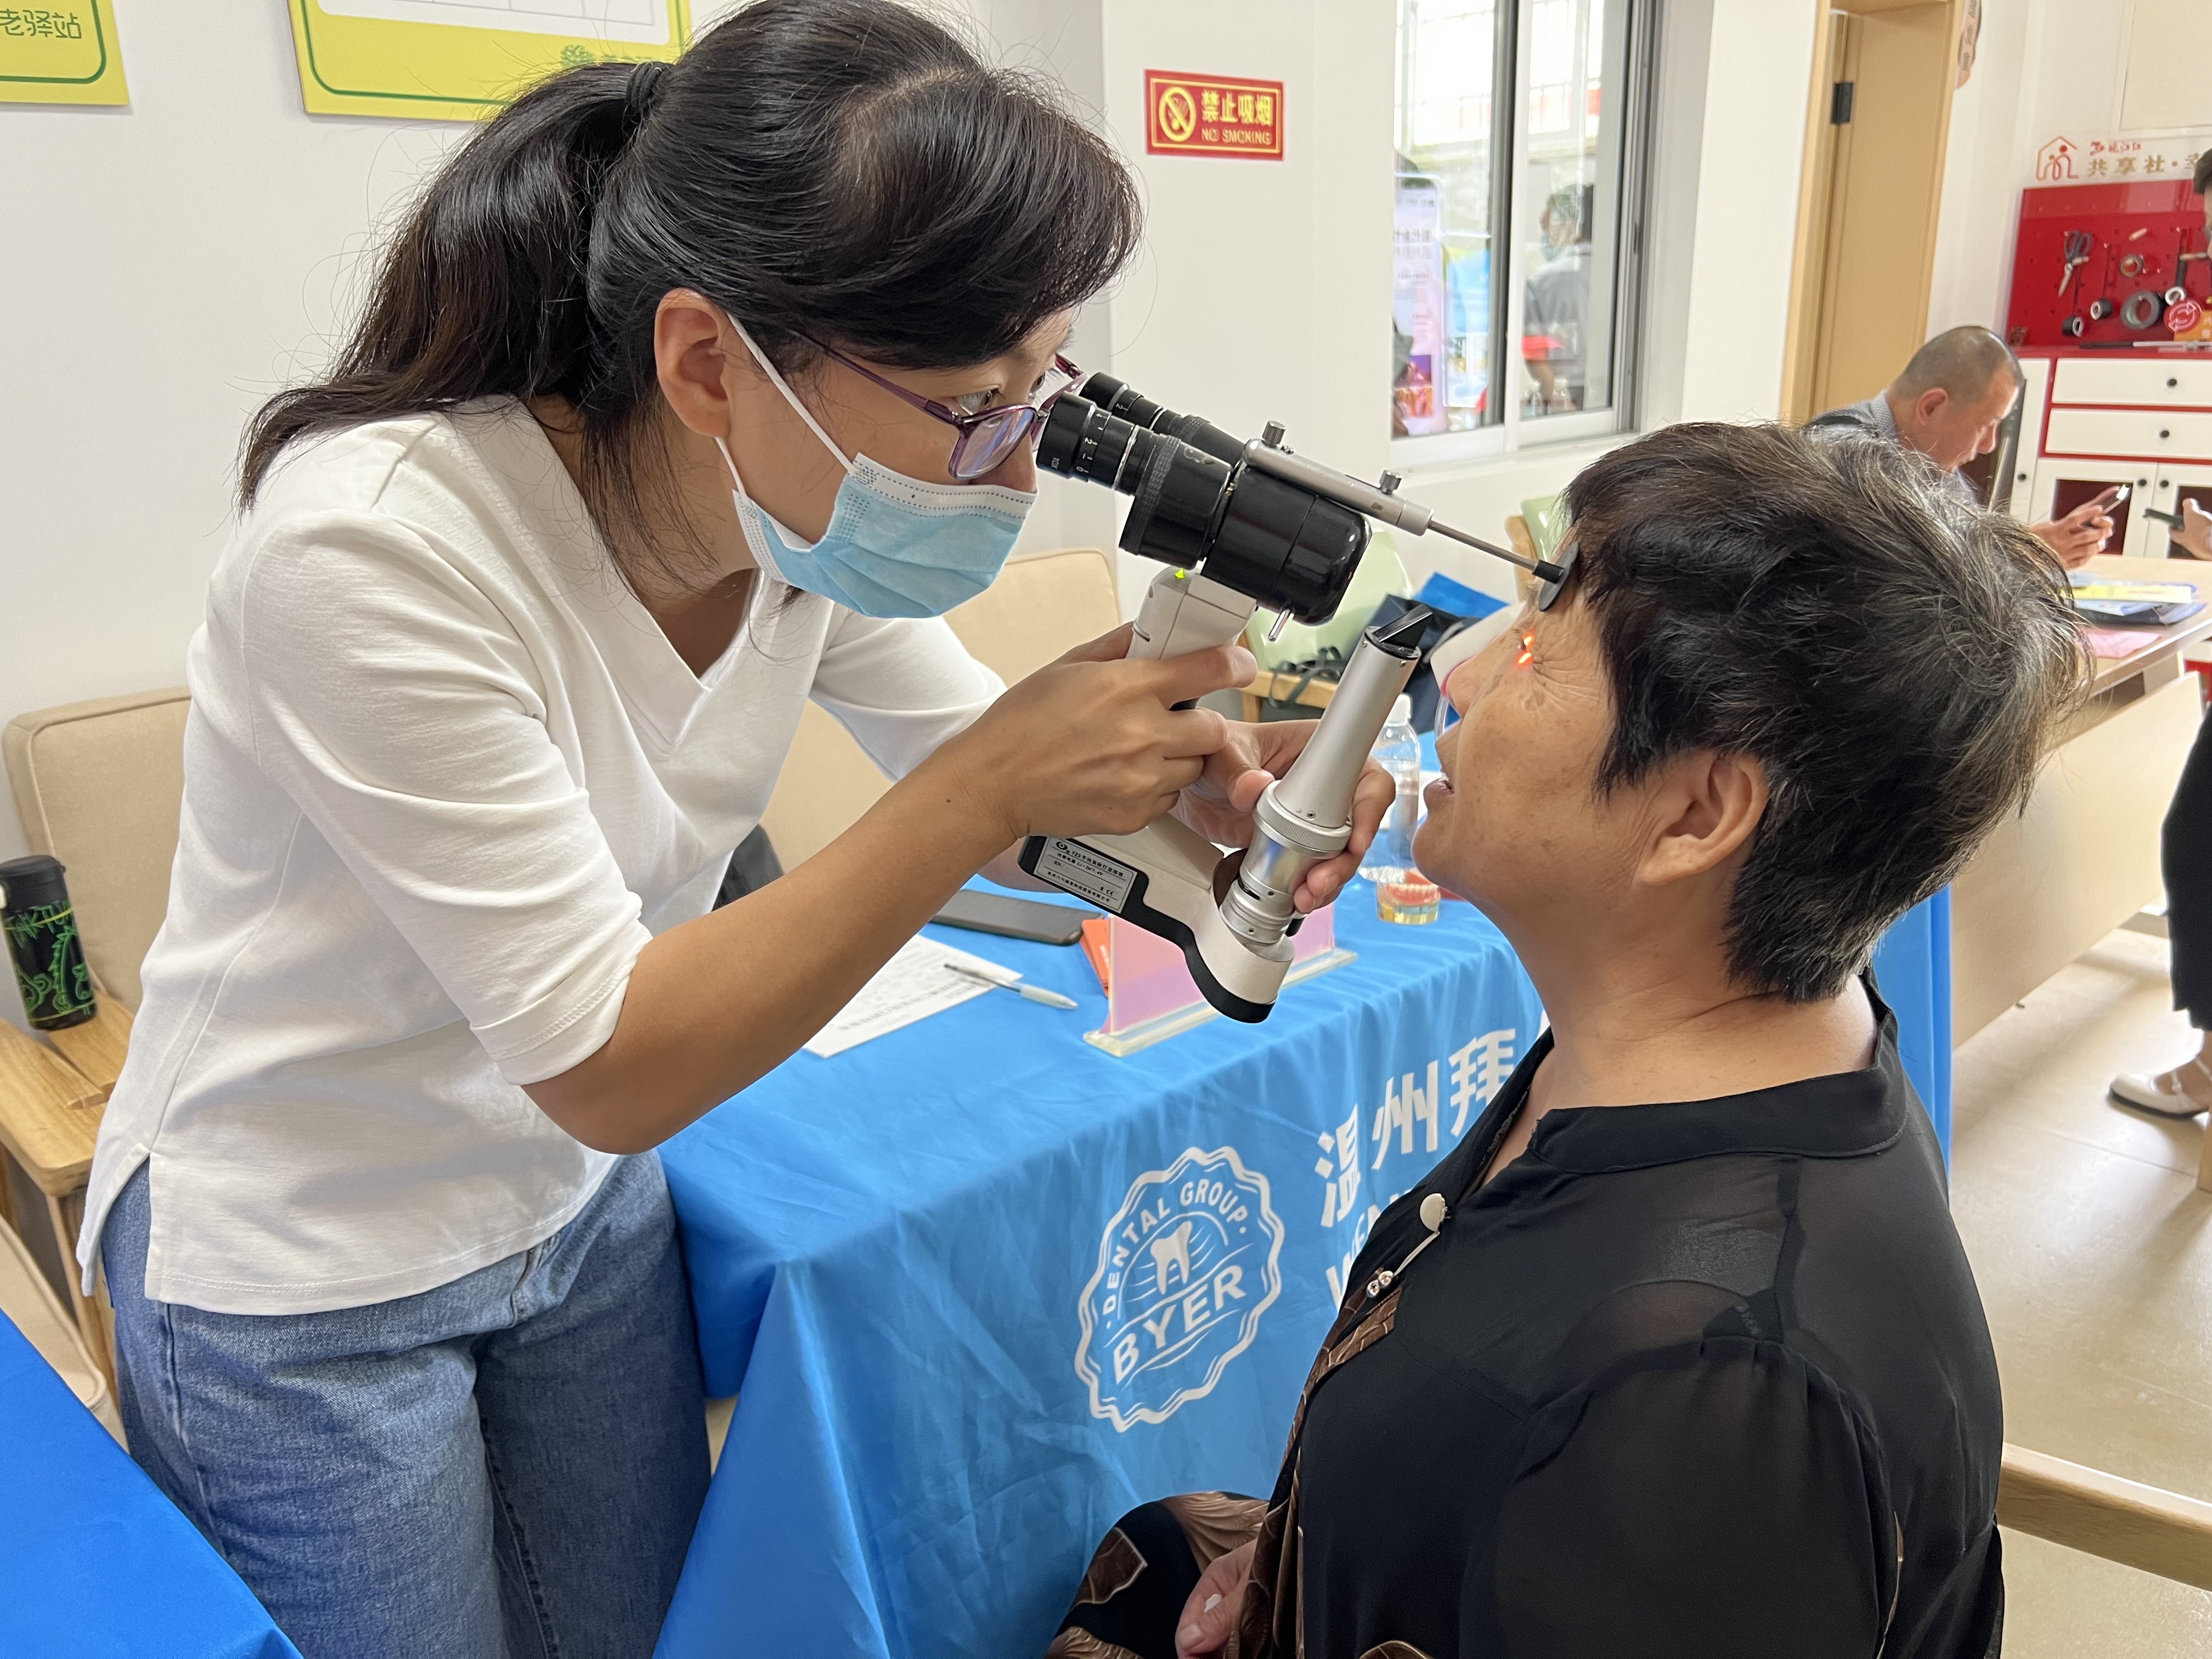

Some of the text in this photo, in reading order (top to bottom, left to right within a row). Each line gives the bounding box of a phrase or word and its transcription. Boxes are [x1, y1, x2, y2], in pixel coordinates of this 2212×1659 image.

[0, 9, 82, 39] 老驿站
[1201, 89, 1273, 127] 禁止吸烟
[1201, 128, 1272, 145] NO SMOKING
[1314, 1010, 1550, 1227] 温州拜
[1103, 1197, 1171, 1316] DENTAL
[1113, 1265, 1247, 1385] BYER
